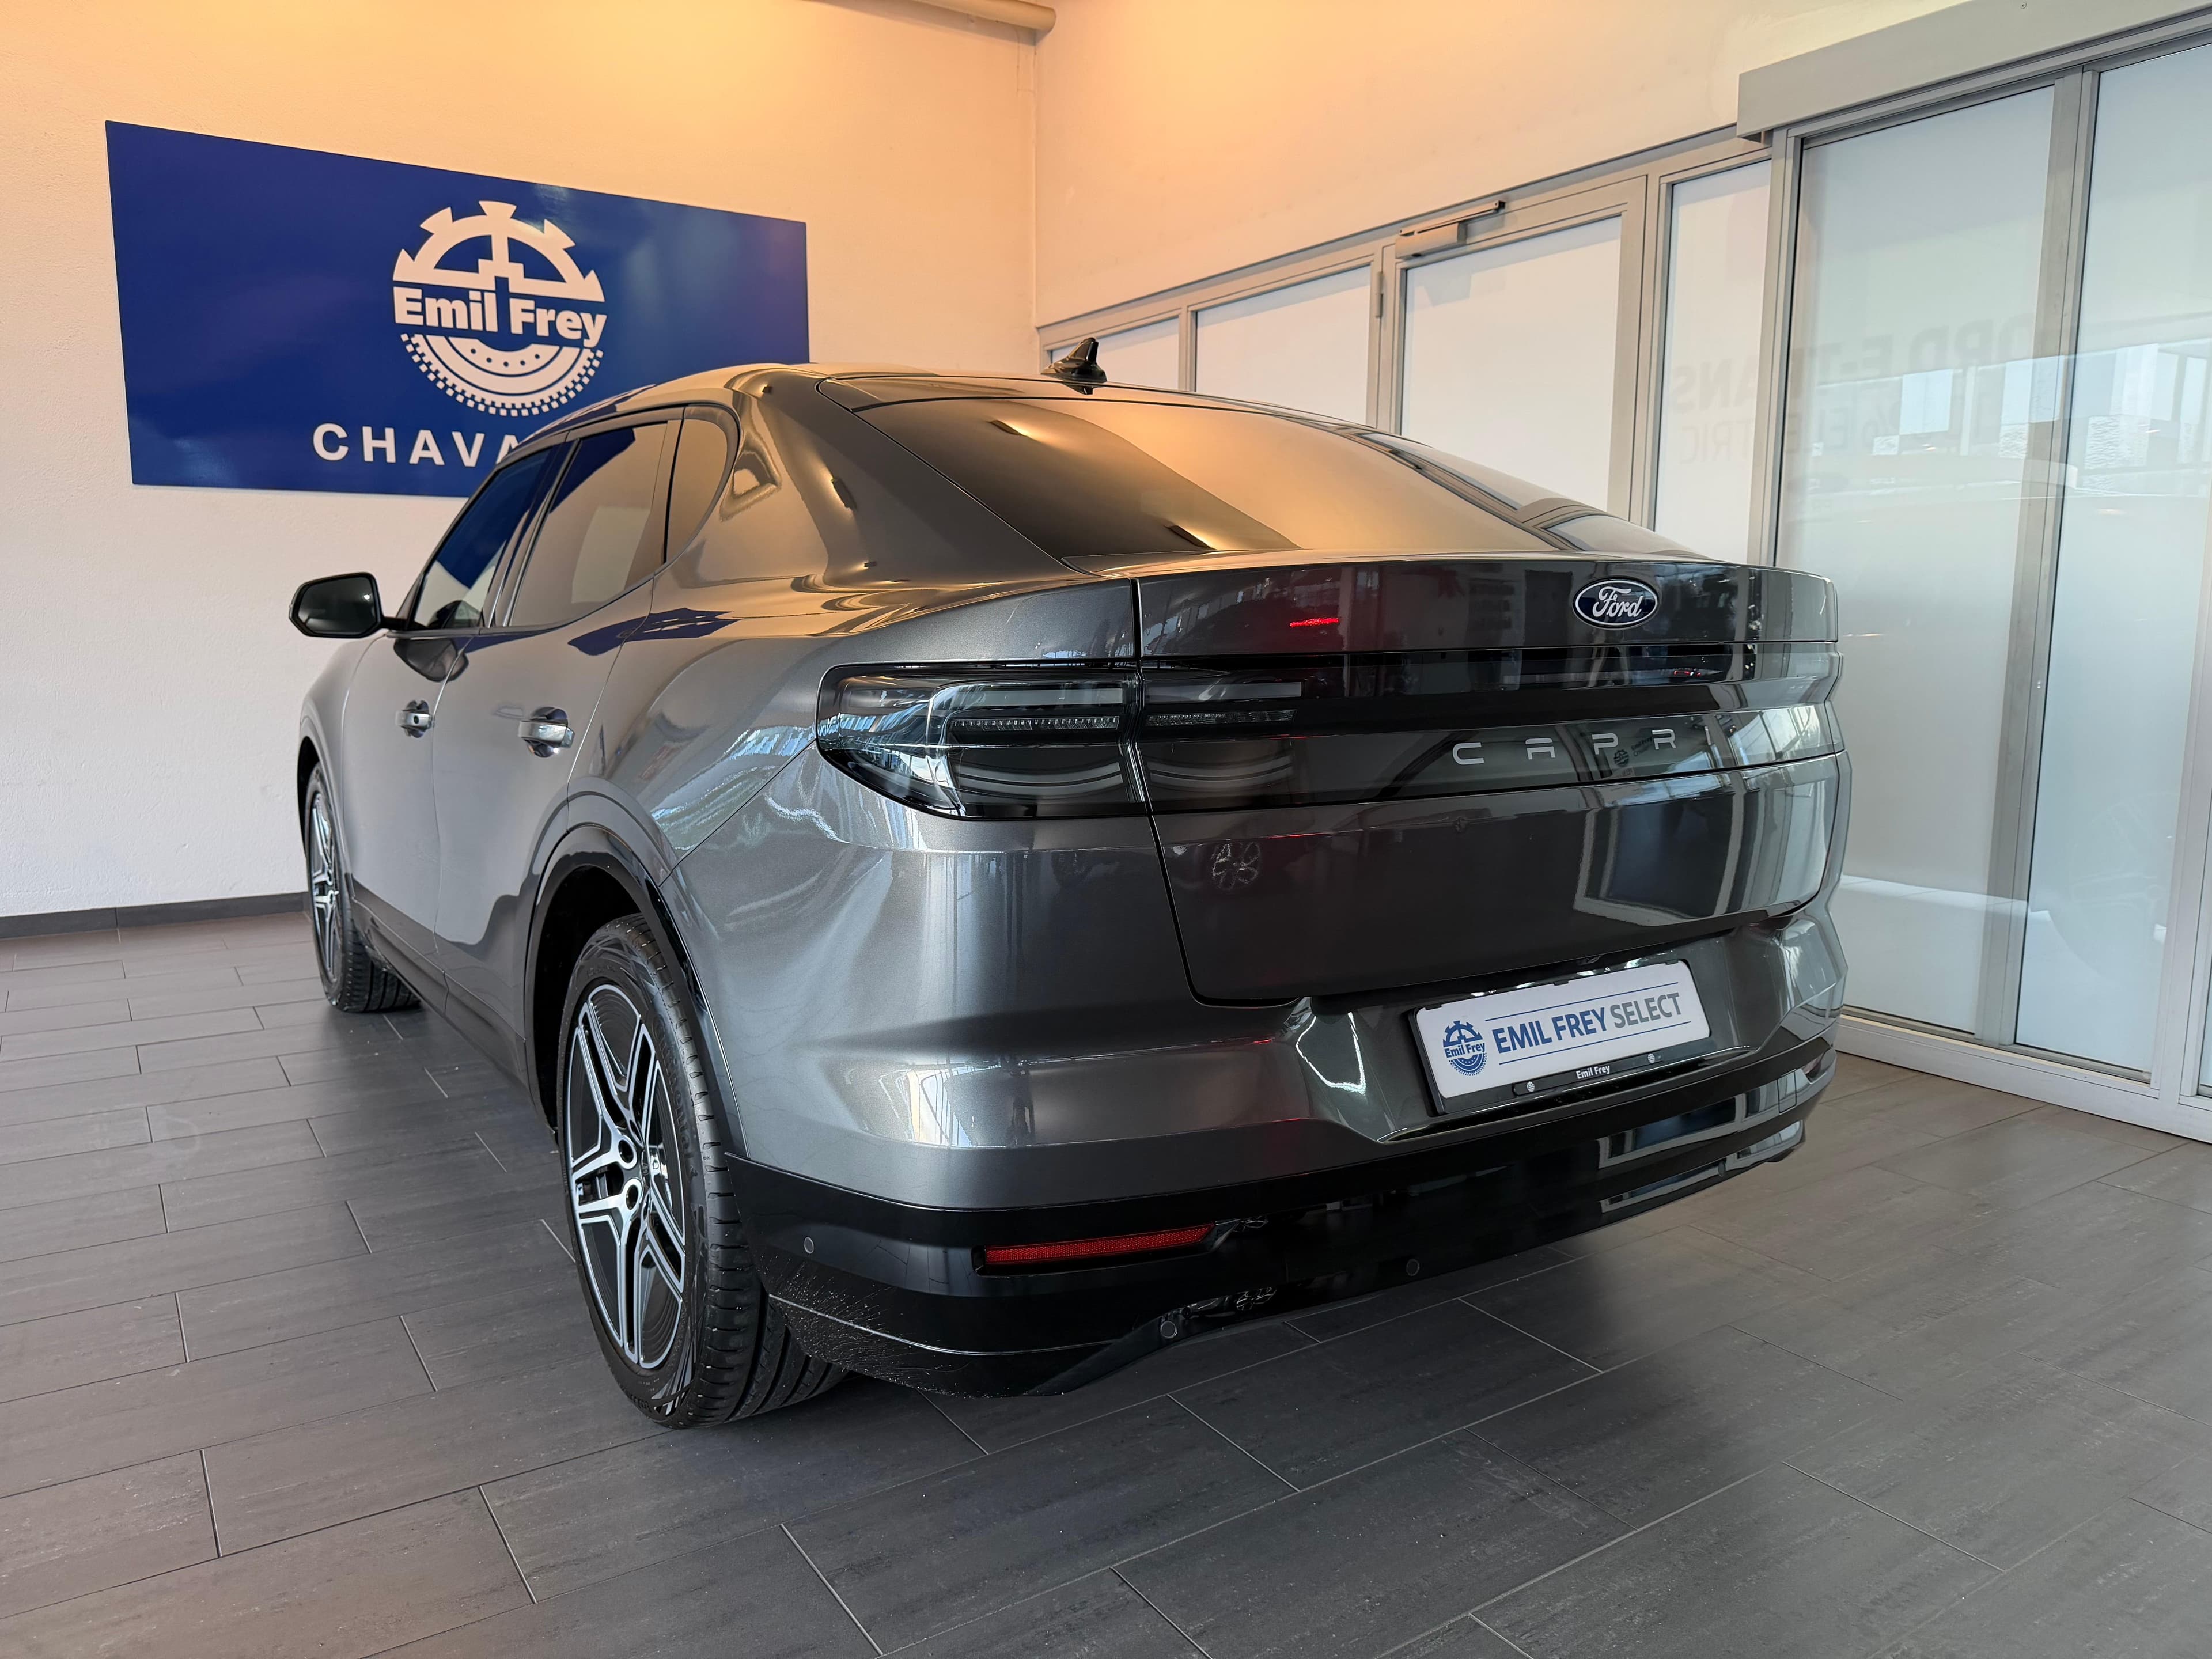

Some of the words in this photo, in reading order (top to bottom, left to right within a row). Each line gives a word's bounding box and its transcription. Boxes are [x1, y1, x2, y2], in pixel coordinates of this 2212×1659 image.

[393, 286, 498, 332] Emil
[509, 297, 607, 348] Frey
[312, 422, 520, 468] CHAVA
[1592, 586, 1643, 618] Ford
[1452, 726, 1713, 766] CAPRI
[1492, 1016, 1552, 1054] EMIL
[1552, 1007, 1608, 1041] FREY
[1611, 992, 1682, 1029] SELECT
[1444, 1044, 1465, 1058] Emil
[1465, 1043, 1485, 1053] Frey
[1575, 1069, 1593, 1080] Emil
[1594, 1065, 1610, 1076] Frey
